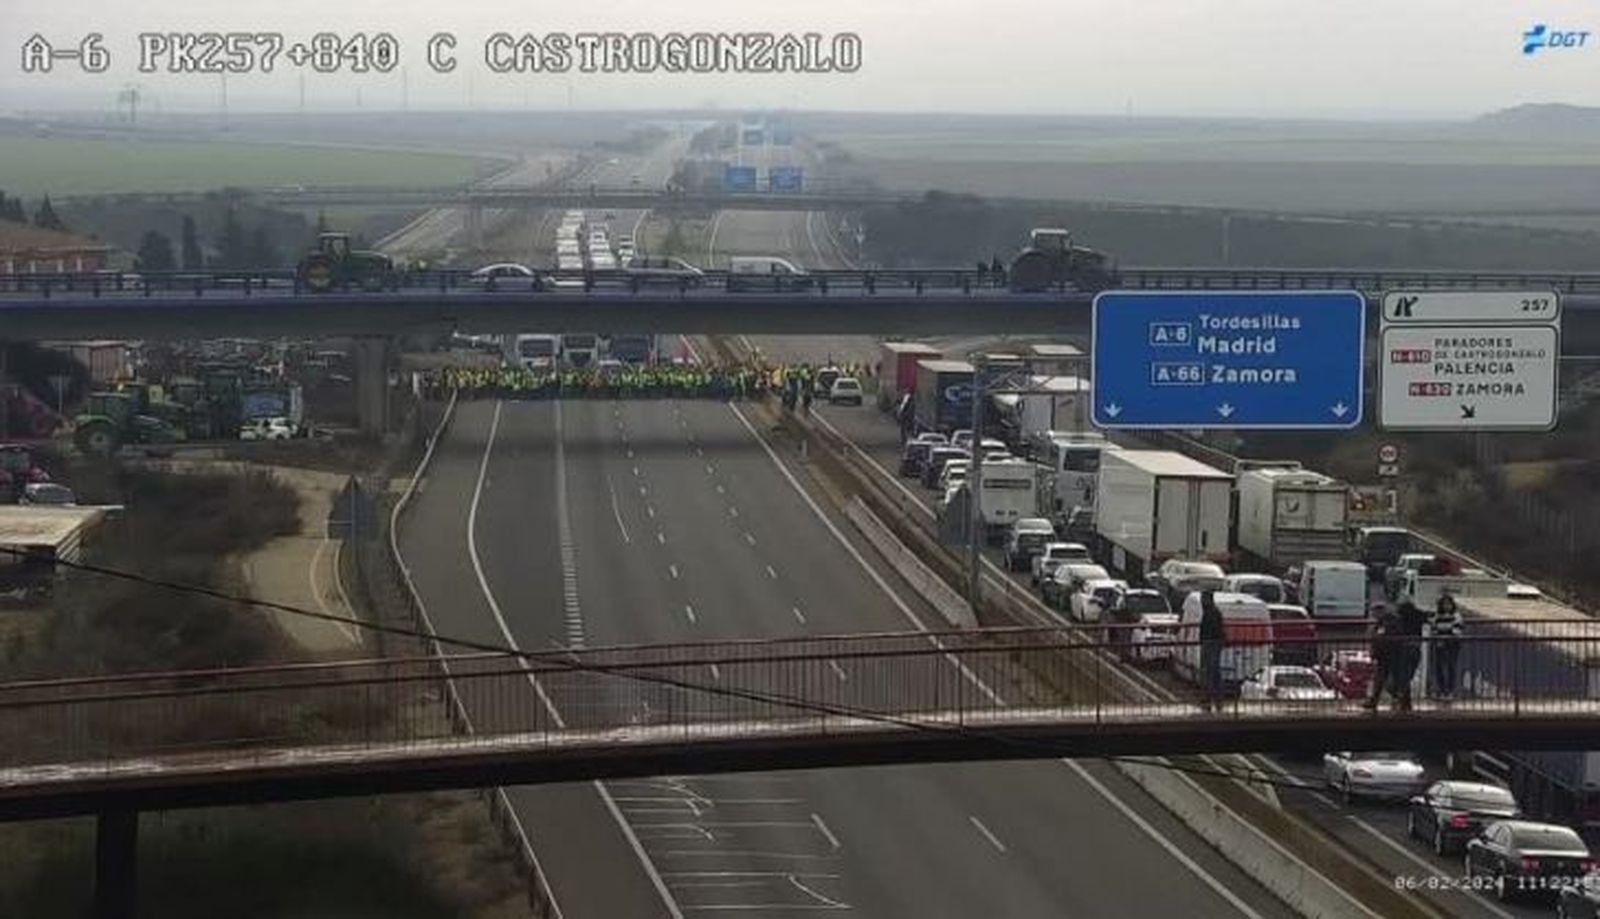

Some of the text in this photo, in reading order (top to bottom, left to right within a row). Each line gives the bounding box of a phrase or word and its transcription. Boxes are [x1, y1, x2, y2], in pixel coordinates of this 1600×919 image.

[1521, 299, 1549, 312] 257
[1199, 314, 1301, 330] Tordesillas
[1198, 336, 1276, 354] Madrid
[1211, 365, 1296, 384] Zamora
[1434, 362, 1515, 375] PALENCIA
[1456, 383, 1526, 396] ZAMORA
